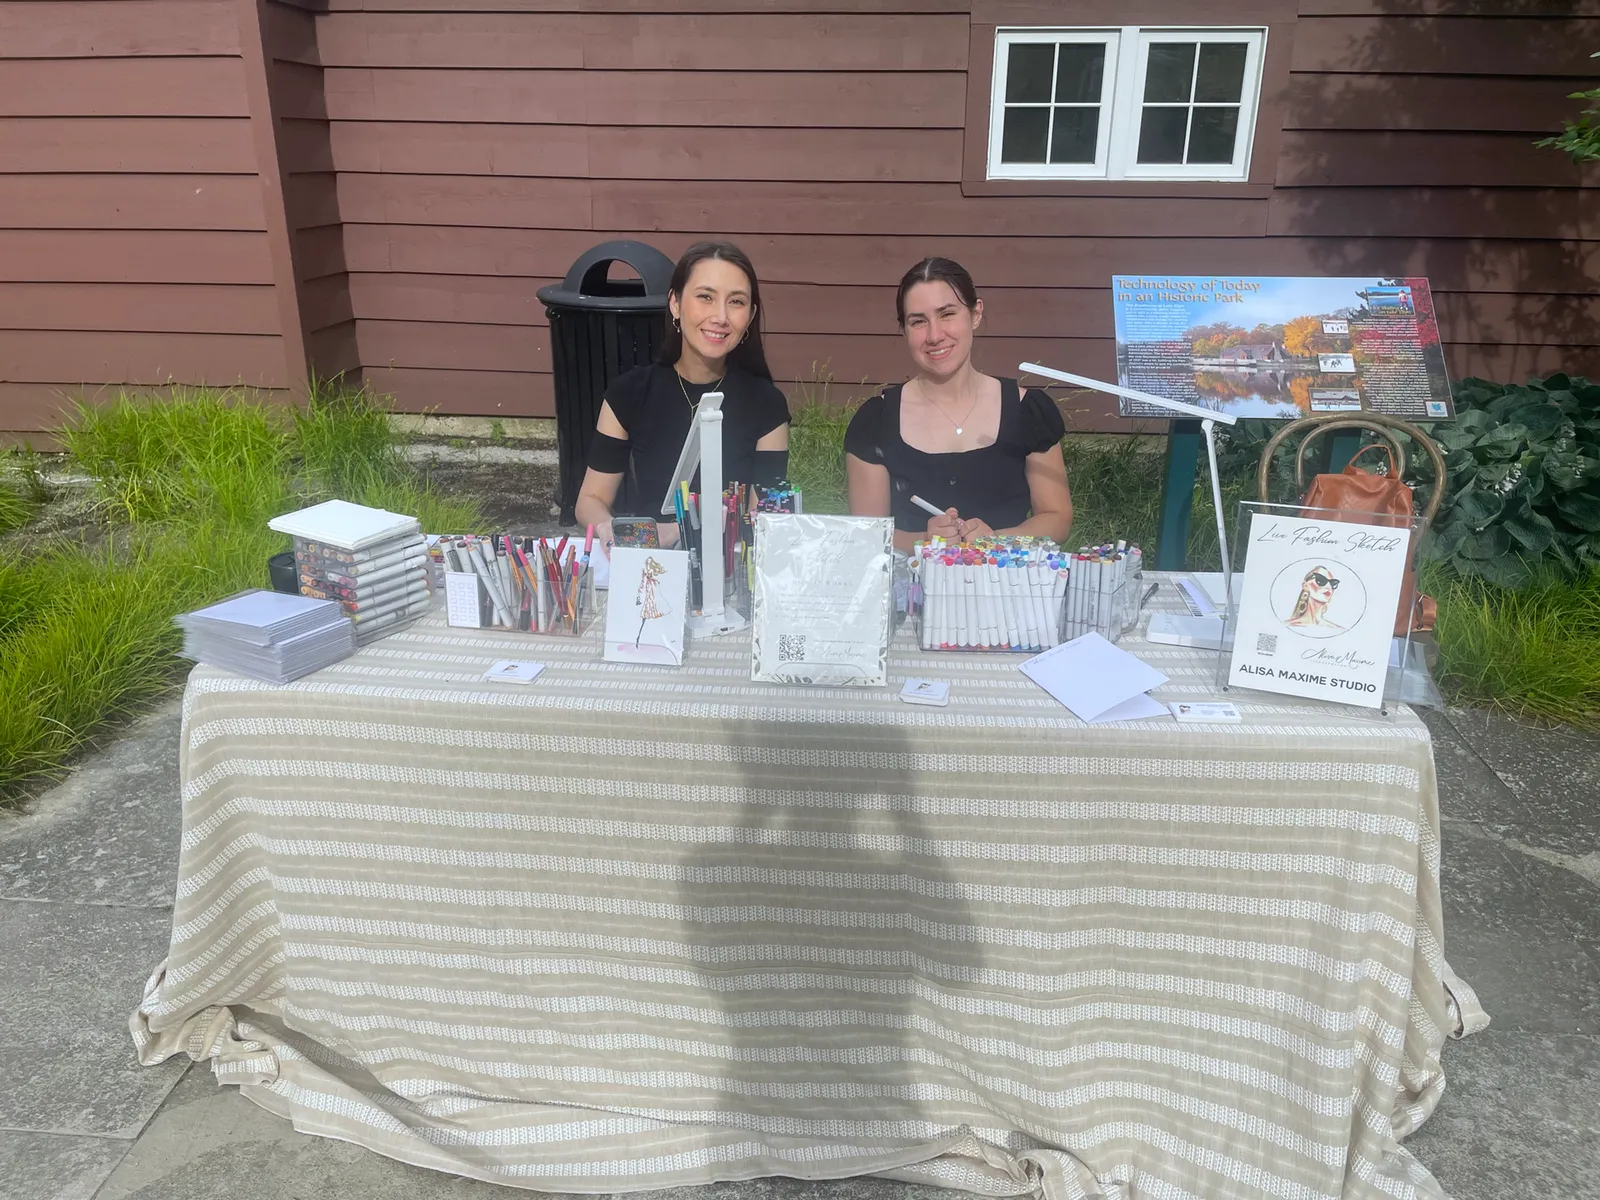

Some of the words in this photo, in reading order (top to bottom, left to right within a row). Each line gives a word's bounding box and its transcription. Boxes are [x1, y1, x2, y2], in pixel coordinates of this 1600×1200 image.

[1116, 278, 1197, 293] Technology
[1201, 279, 1218, 292] of
[1219, 280, 1260, 293] Today
[1118, 292, 1132, 301] in
[1135, 292, 1153, 302] an
[1157, 292, 1210, 302] Historic
[1214, 292, 1243, 303] Park
[1291, 526, 1339, 546] Fashion
[1344, 531, 1402, 552] Sketch
[1239, 664, 1275, 677] ALISA
[1278, 670, 1327, 685] MAXIME
[1330, 678, 1377, 693] STUDIO
